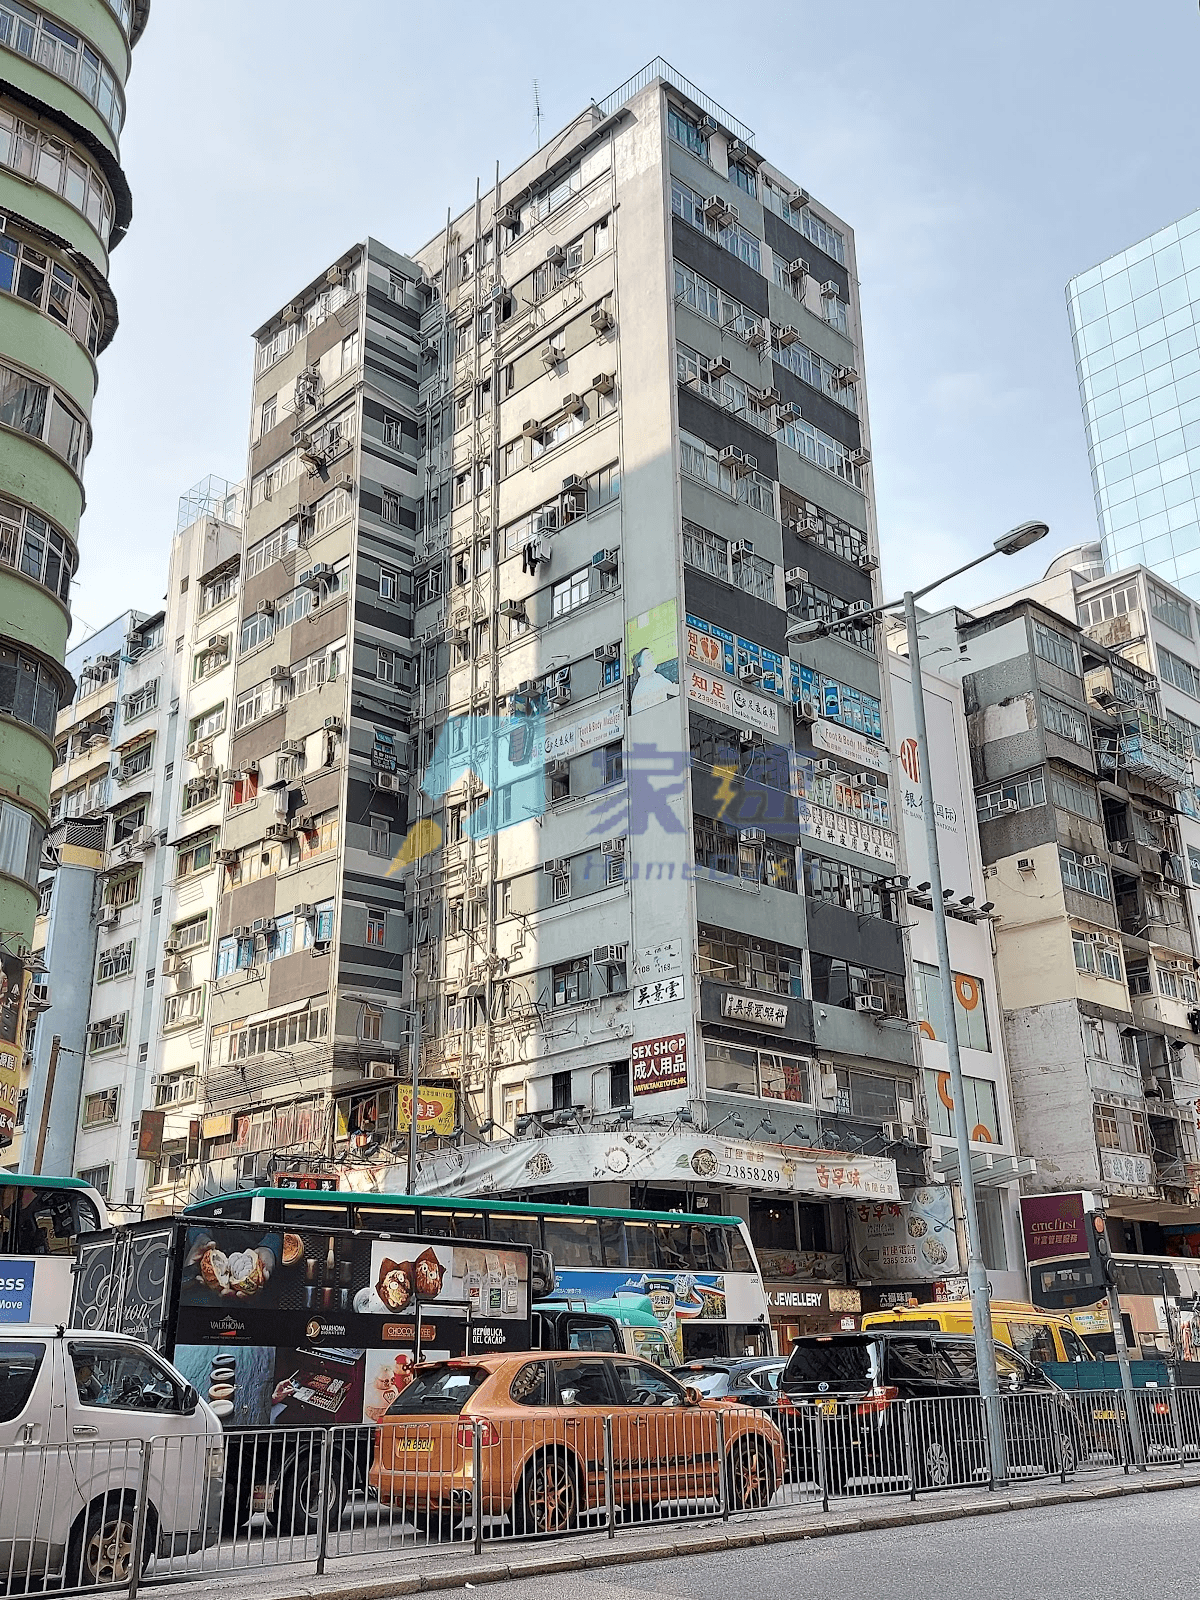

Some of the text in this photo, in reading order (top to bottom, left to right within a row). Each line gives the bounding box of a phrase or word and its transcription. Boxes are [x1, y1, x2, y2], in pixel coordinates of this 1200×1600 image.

[687, 630, 700, 660] 知足
[691, 672, 727, 701] 知足
[633, 1038, 686, 1060] SEX SHOP
[634, 1053, 686, 1081] 成人用品
[725, 1164, 781, 1184] 23858289
[816, 1164, 862, 1190] 古早味
[857, 1203, 905, 1223] 古早味
[775, 1292, 823, 1307] JEWELLERY
[210, 1320, 246, 1331] VALRHONA
[320, 1324, 346, 1332] VALRHONA
[472, 1326, 503, 1337] REPÚBLICA
[472, 1336, 483, 1345] DEL
